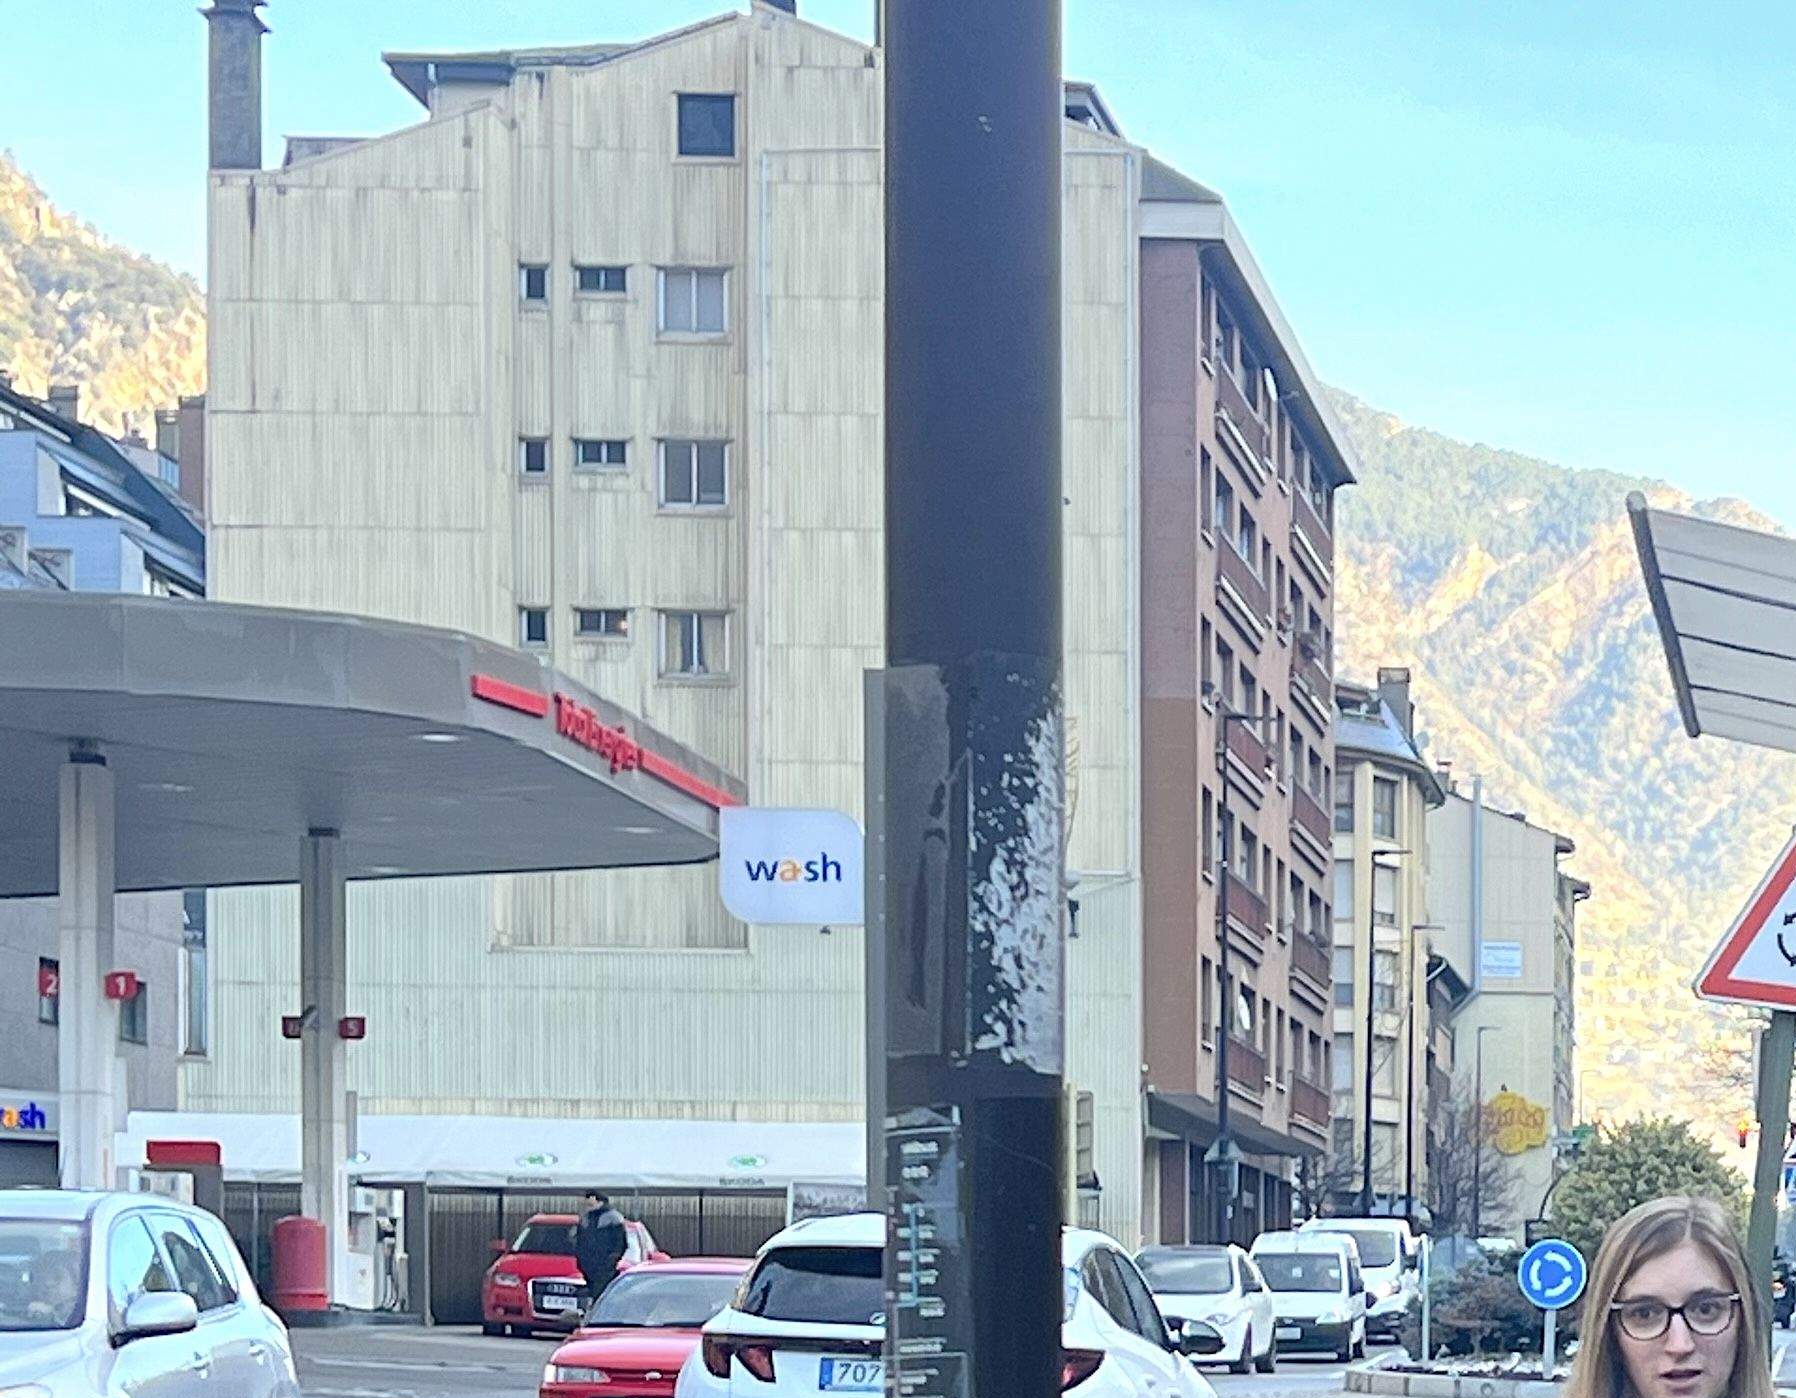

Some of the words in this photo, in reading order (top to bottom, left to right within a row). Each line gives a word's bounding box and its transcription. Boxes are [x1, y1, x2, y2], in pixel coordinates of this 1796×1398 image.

[745, 851, 842, 882] wash
[116, 976, 126, 995] 1
[0, 1102, 46, 1129] ash
